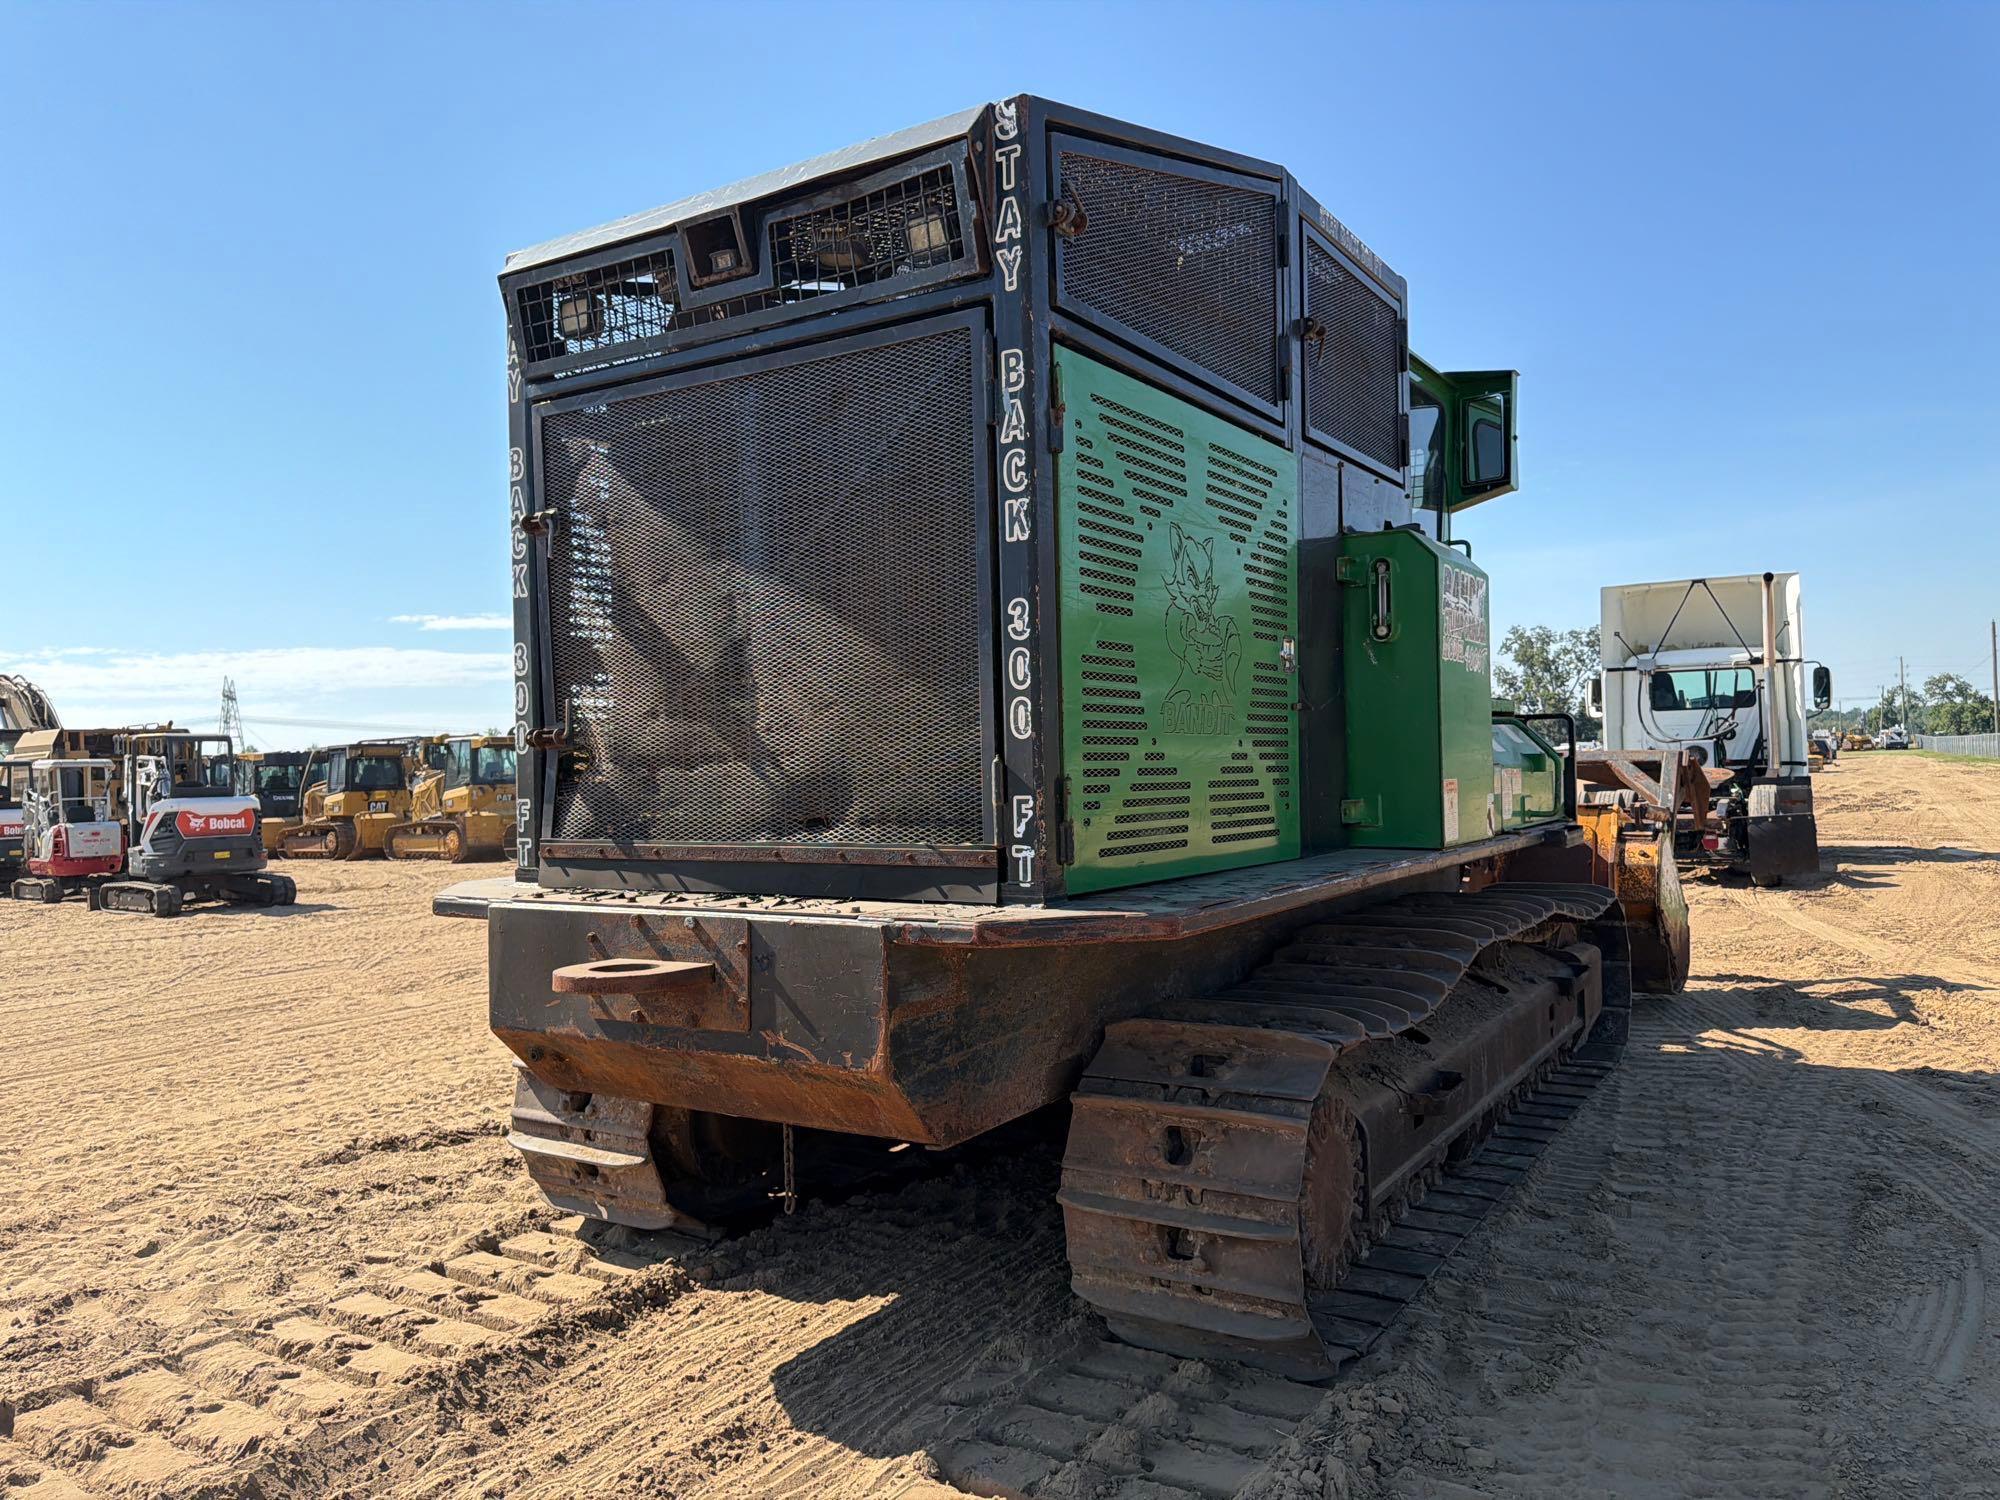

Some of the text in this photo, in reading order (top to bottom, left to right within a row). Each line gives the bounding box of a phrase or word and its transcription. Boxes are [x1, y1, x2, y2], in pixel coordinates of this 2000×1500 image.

[994, 100, 1035, 888] STAY BACK 300 FT
[507, 336, 532, 867] AY BACK 300 FT
[1160, 701, 1235, 736] BANDIT
[370, 802, 387, 813] CAT
[496, 794, 512, 803] CAT
[209, 817, 246, 830] Bobcat
